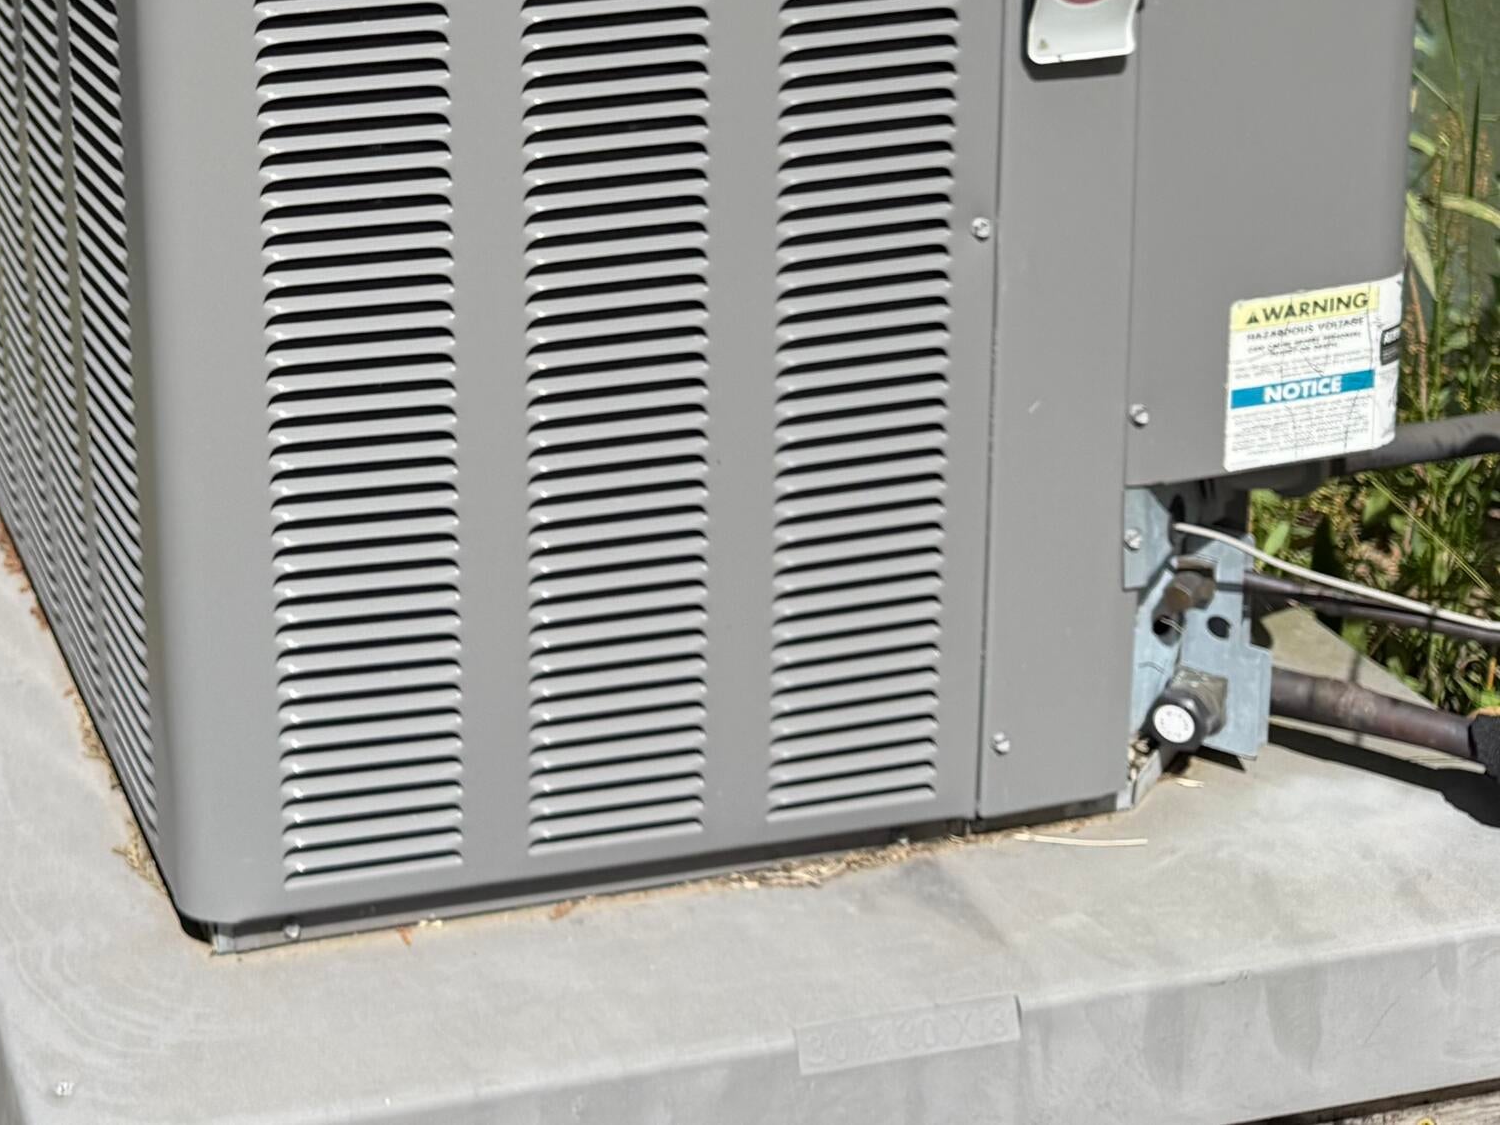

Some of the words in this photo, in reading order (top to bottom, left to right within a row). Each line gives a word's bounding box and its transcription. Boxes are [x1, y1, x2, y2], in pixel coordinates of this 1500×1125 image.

[1263, 293, 1368, 321] WARNING
[1247, 324, 1314, 340] HAZARDOUS
[1318, 317, 1364, 331] VOLTAGE
[1264, 376, 1343, 404] NOTICE
